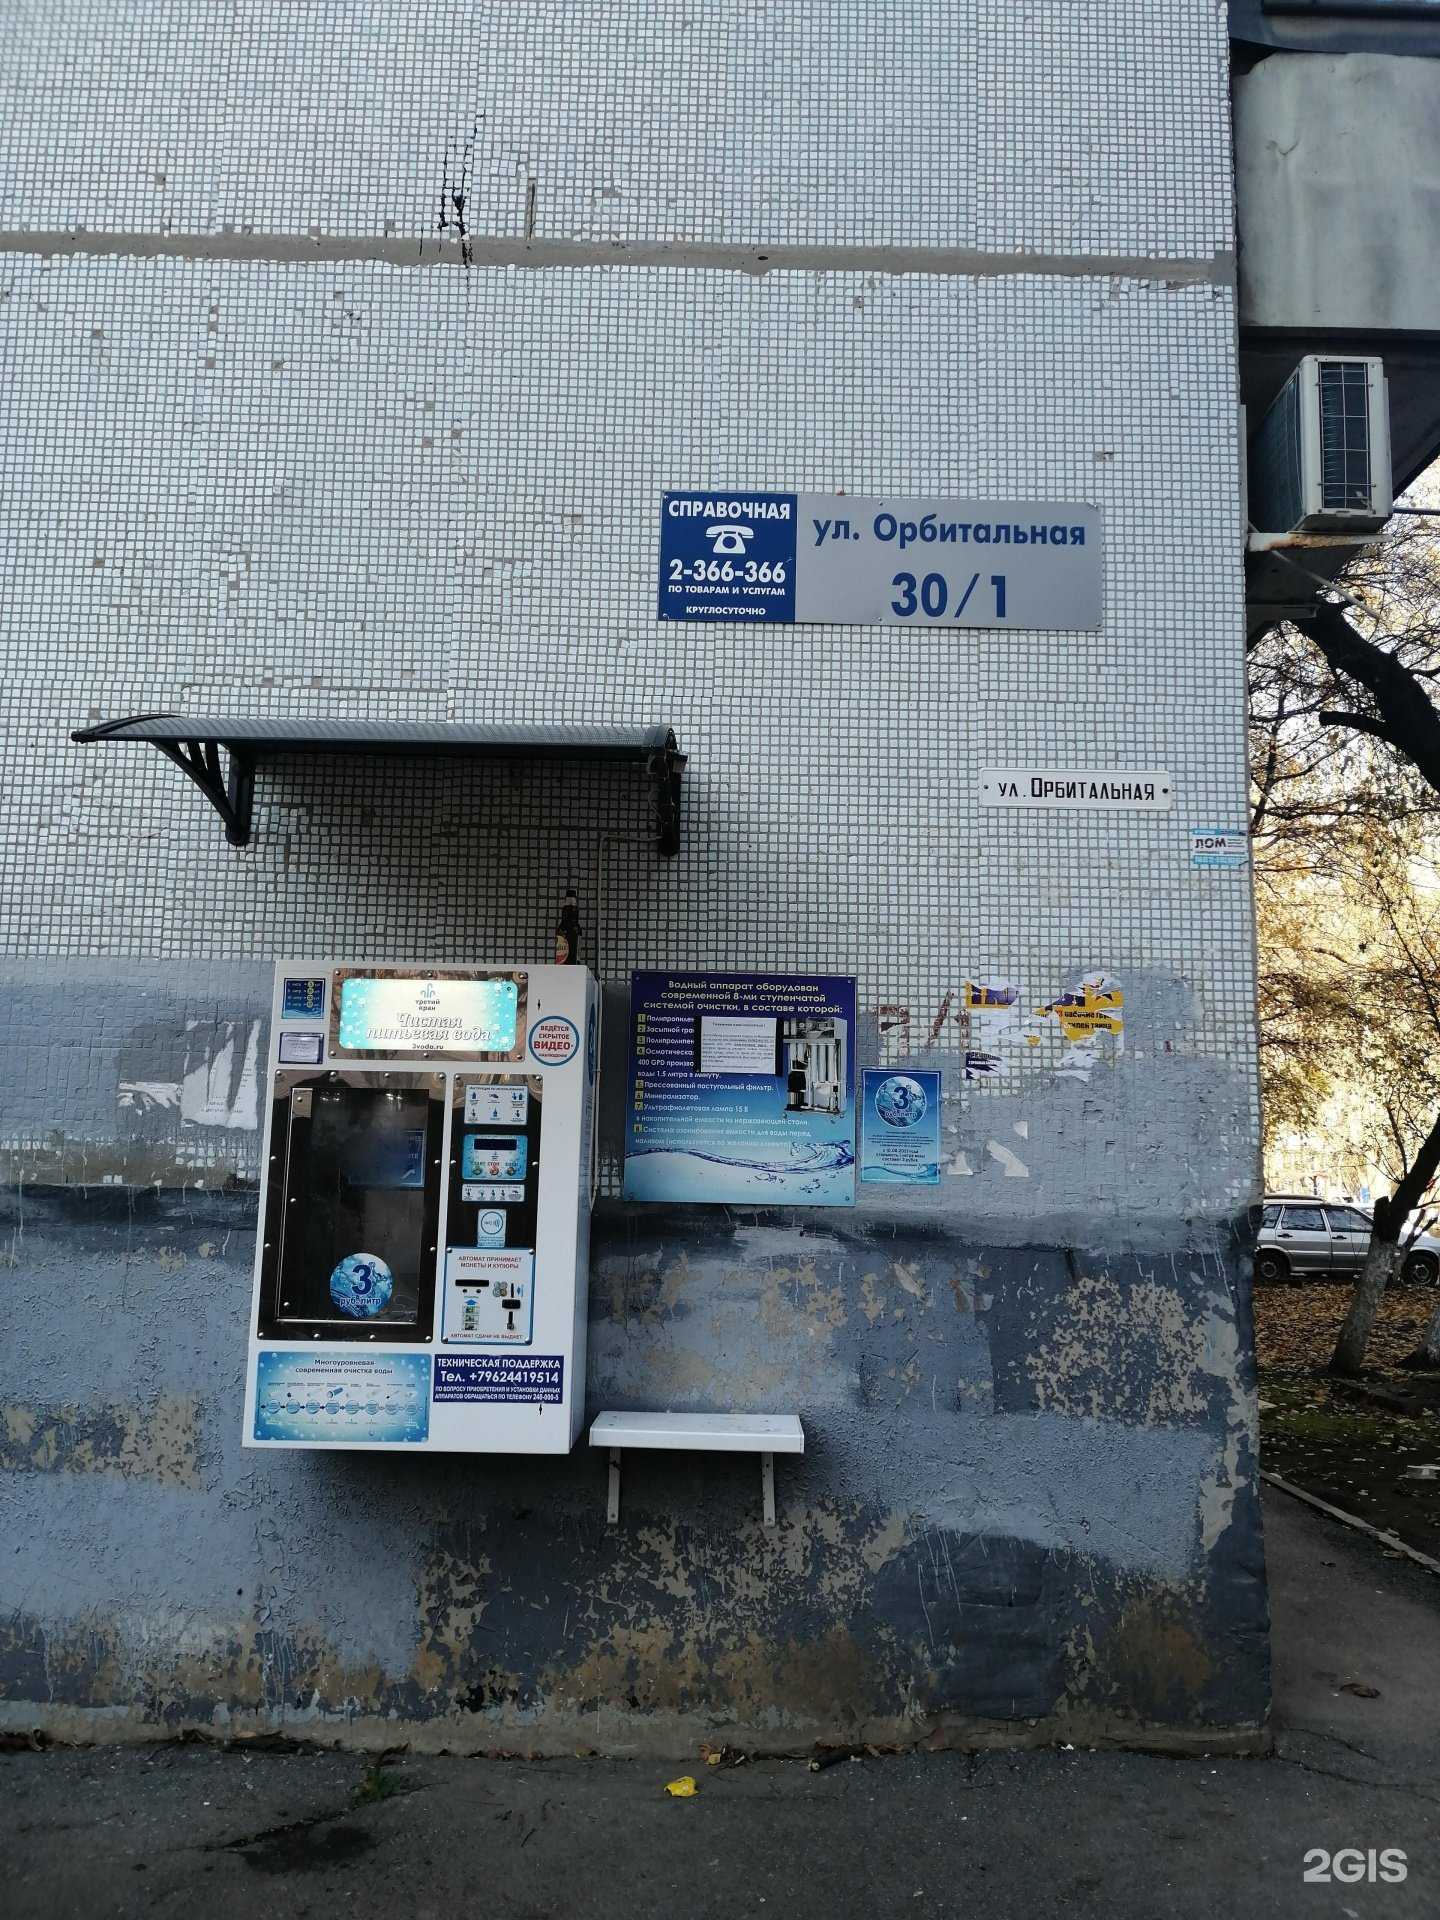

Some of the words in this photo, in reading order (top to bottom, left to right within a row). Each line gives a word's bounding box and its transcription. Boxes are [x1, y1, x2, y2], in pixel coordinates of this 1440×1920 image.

[668, 501, 790, 520] СПРАВОЧНАЯ
[813, 519, 860, 546] ул.
[873, 513, 1086, 549] Орбитальная
[668, 558, 786, 583] 2-366-366
[668, 585, 682, 593] ПО
[685, 586, 729, 594] ТОВАРАМ
[743, 587, 785, 595] УСЛУГАМ
[891, 572, 1006, 618] 30/1
[686, 606, 766, 615] КРУГЛОСУТОЧНО
[668, 980, 707, 989] Водный
[709, 983, 754, 991] аппарат
[756, 982, 819, 992] оборудован
[661, 991, 731, 1000] современной
[733, 992, 757, 1000] 8-ми
[760, 994, 826, 1002] ступенчатой
[643, 1001, 694, 1009] системой
[797, 1005, 843, 1014] которой:
[398, 1013, 462, 1028] Чистая
[366, 1028, 450, 1040] питьевая
[451, 1026, 493, 1040] вода
[893, 1086, 909, 1109] 3
[352, 1264, 372, 1294] 3
[437, 1358, 500, 1368] ТЕХНИЧЕСКАЯ
[502, 1359, 561, 1369] ПОДДЕРЖКА
[440, 1370, 466, 1382] Тел.
[469, 1371, 559, 1384] +79624419514
